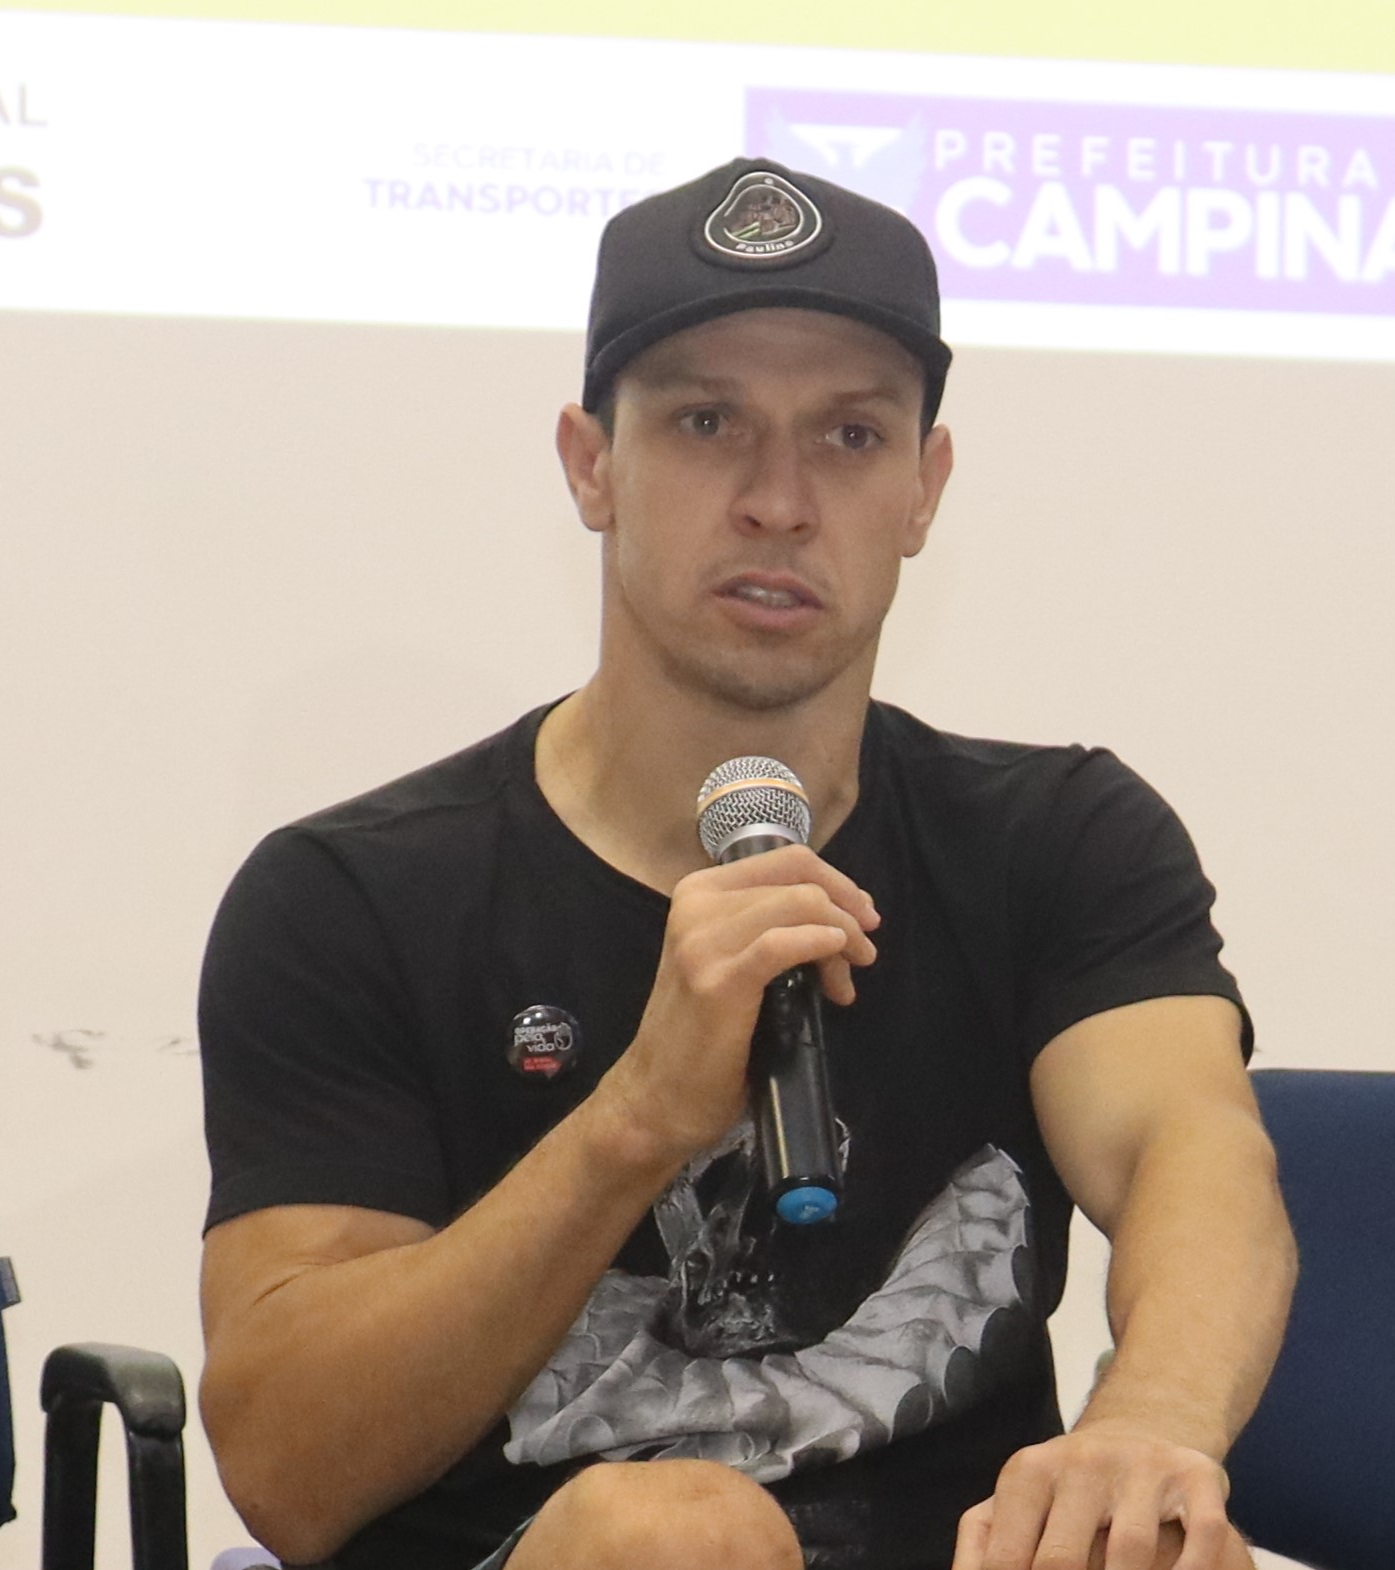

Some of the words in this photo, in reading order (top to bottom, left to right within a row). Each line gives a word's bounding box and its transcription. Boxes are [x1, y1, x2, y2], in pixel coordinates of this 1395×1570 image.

[412, 141, 615, 177] SECRETARIA
[623, 149, 666, 177] DE
[934, 128, 1379, 191] PREFEITURA
[362, 176, 661, 218] TRANSPORTE
